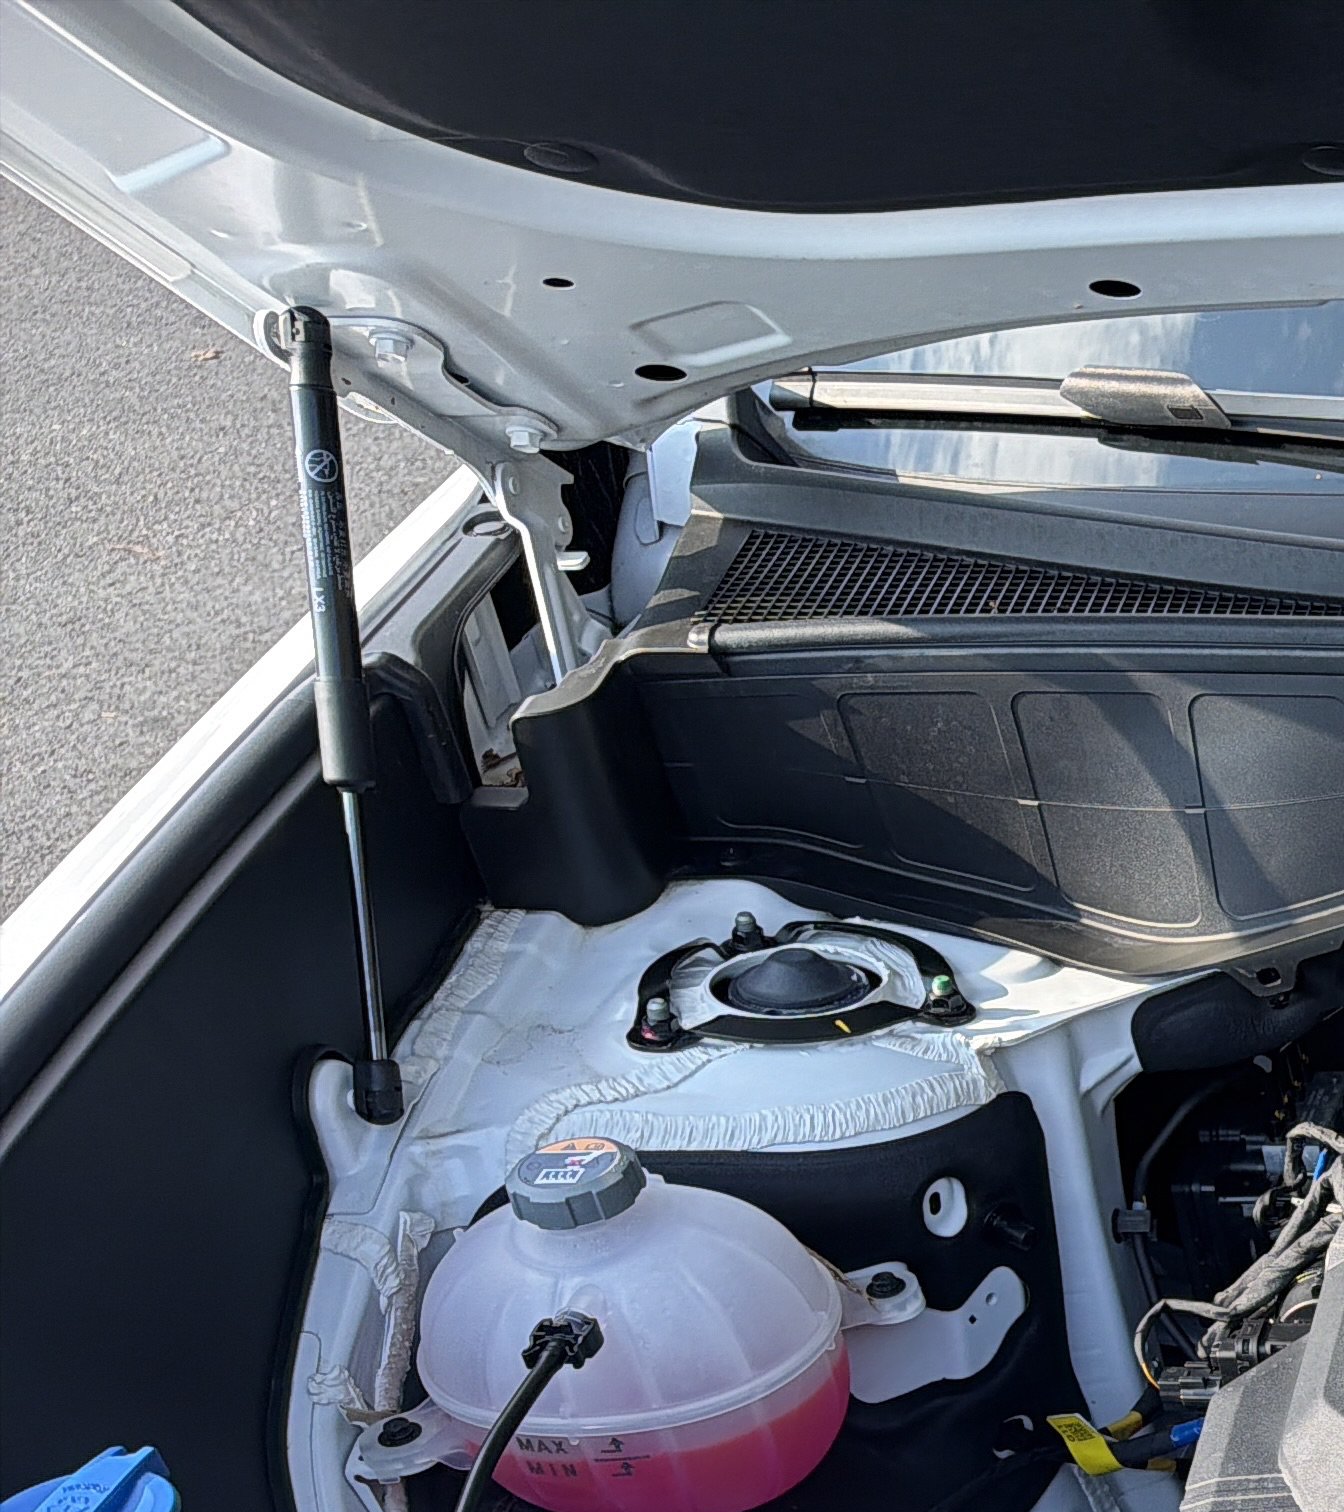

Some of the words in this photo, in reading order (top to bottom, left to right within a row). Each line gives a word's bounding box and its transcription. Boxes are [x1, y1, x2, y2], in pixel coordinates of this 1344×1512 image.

[312, 587, 326, 613] LX3
[515, 1436, 569, 1454] MAX
[526, 1460, 578, 1477] MIN
